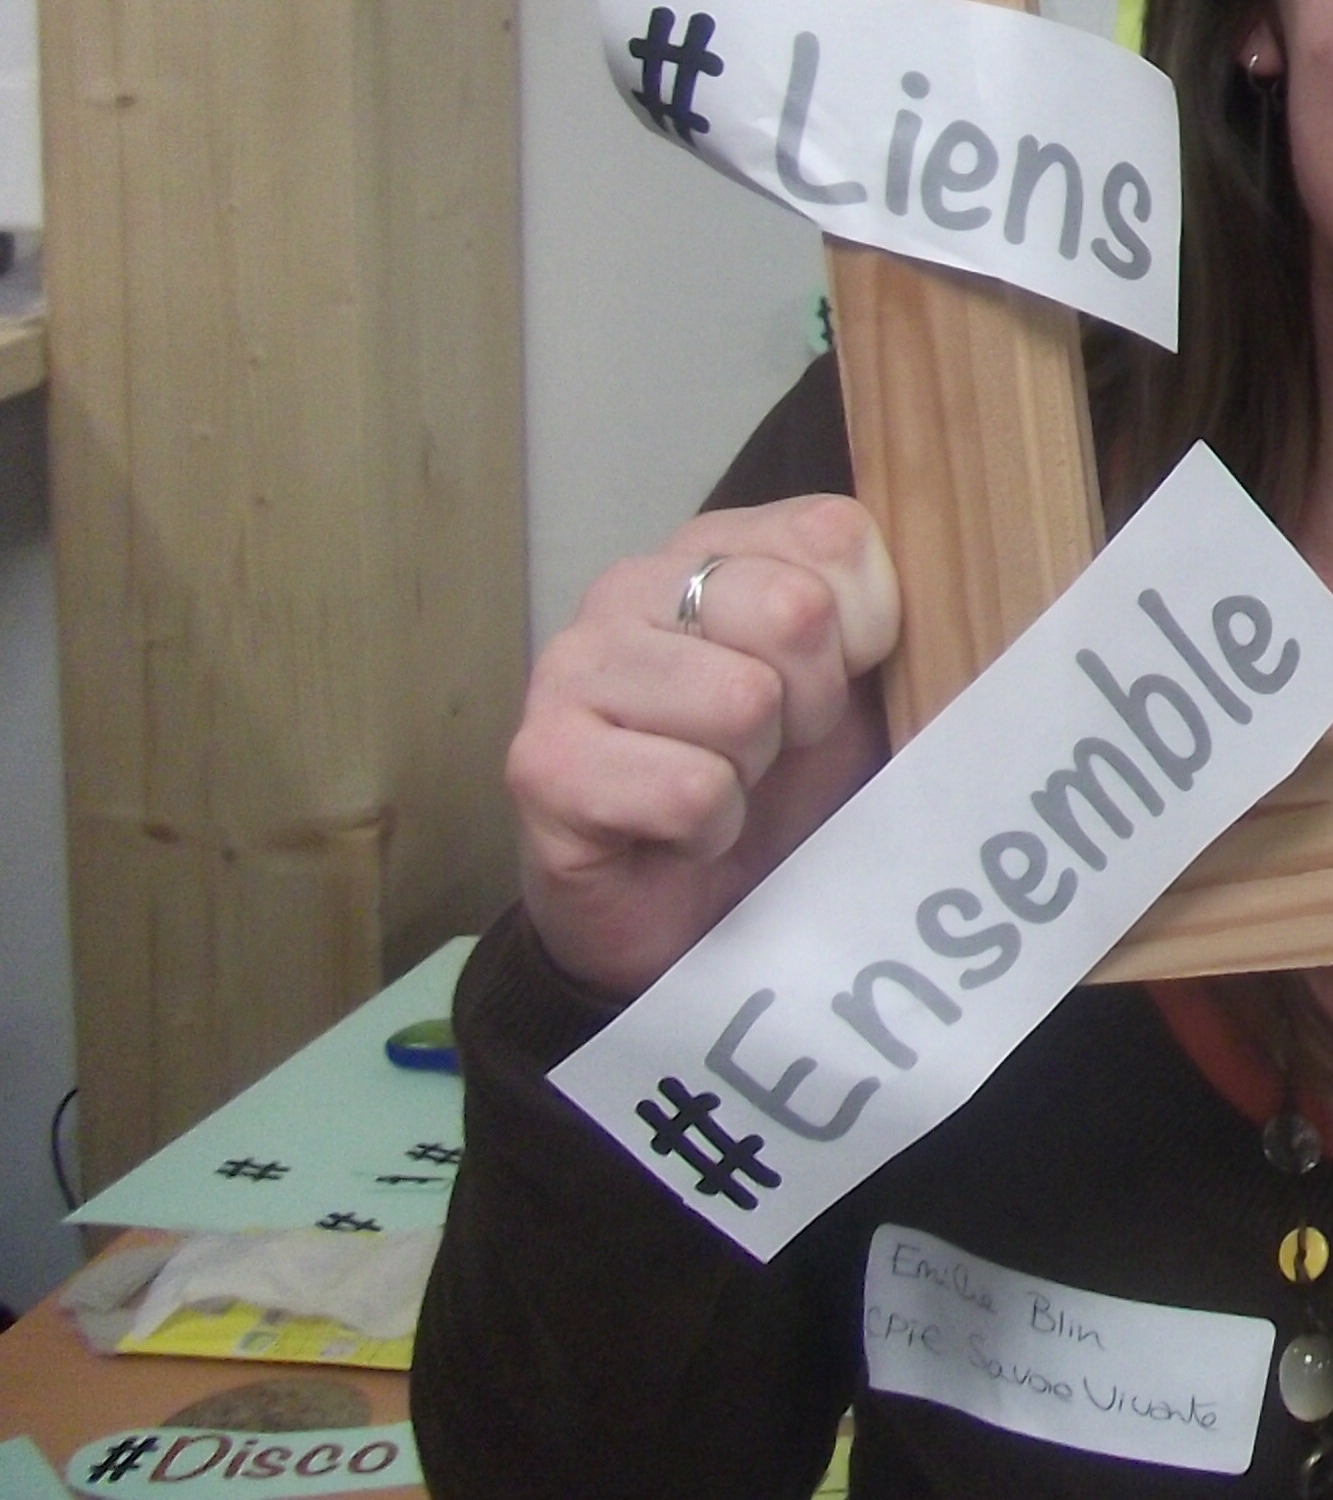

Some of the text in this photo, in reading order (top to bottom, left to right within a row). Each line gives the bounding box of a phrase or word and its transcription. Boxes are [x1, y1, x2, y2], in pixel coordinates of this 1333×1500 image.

[775, 30, 1153, 281] Liens
[636, 587, 1302, 1211] #Ensemble
[86, 1435, 400, 1484] #Disco
